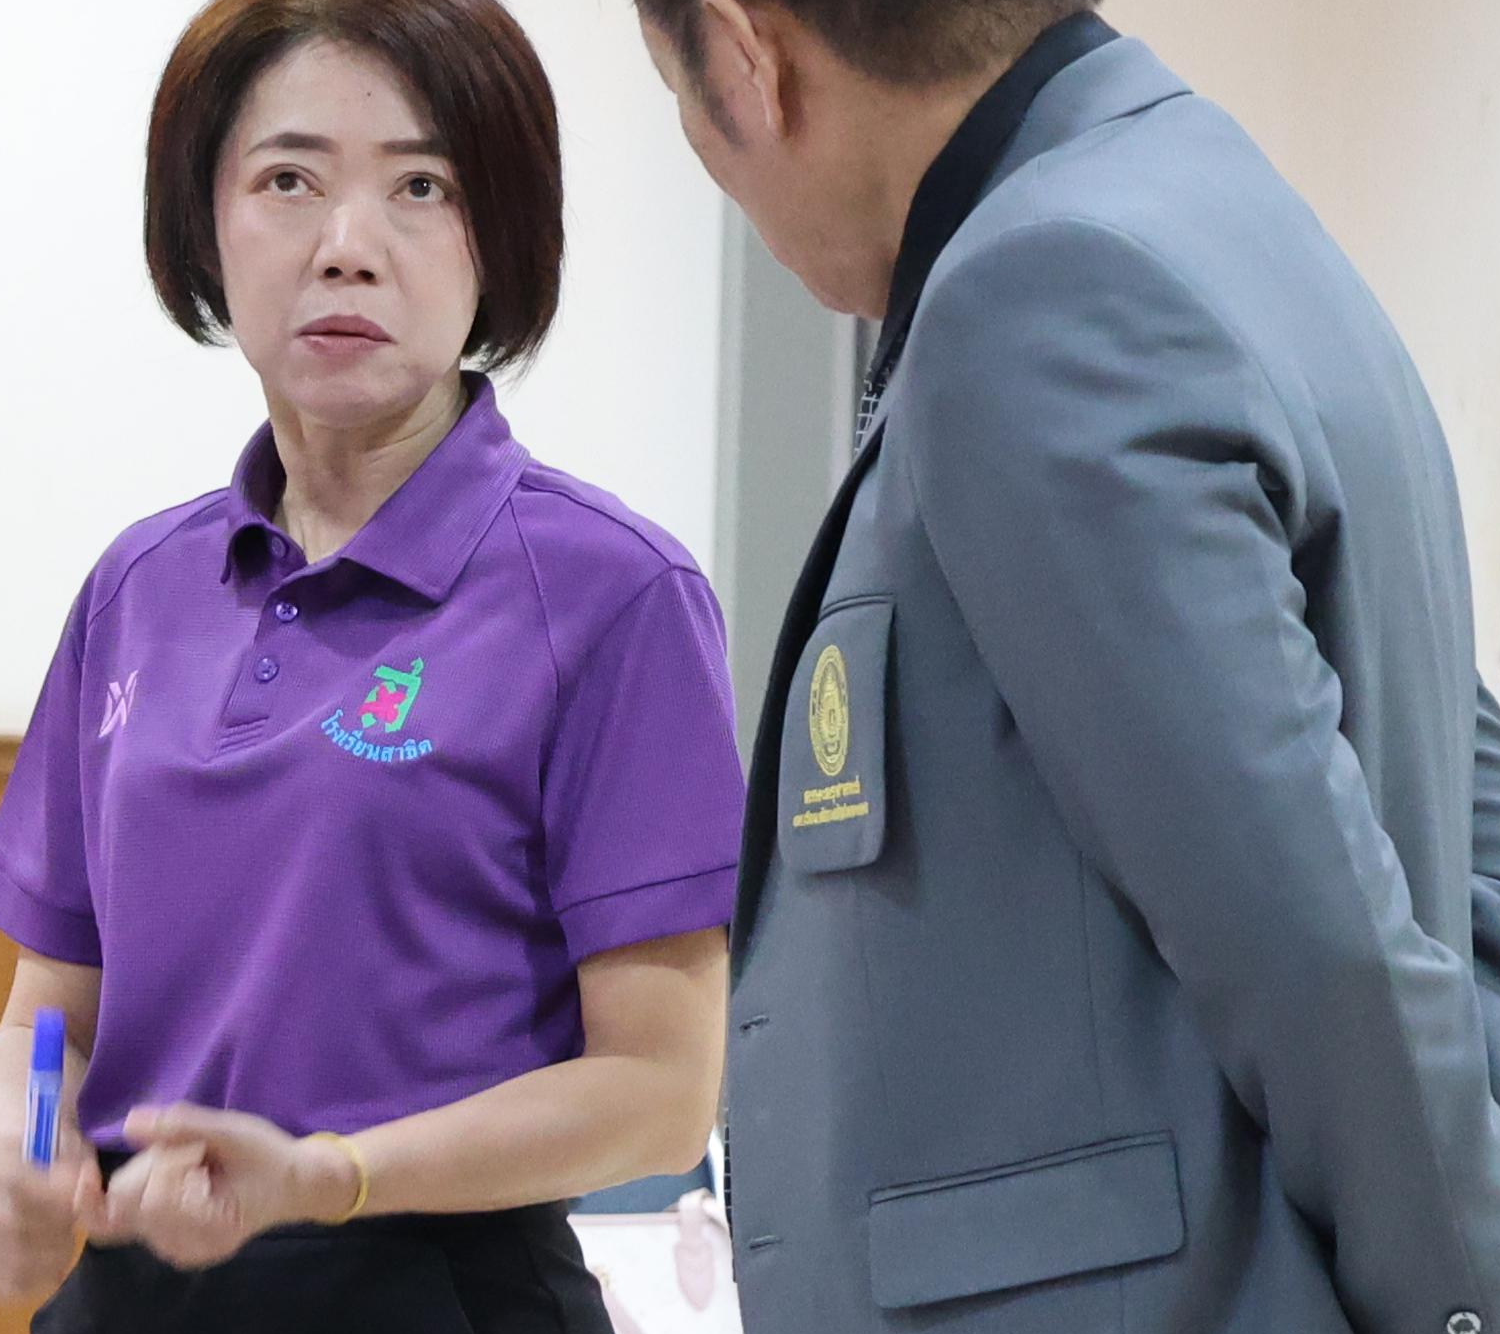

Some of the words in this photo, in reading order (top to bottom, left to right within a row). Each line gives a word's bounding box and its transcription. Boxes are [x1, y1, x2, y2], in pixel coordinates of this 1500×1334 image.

[321, 709, 433, 763] โรงเรียนสาธิต
